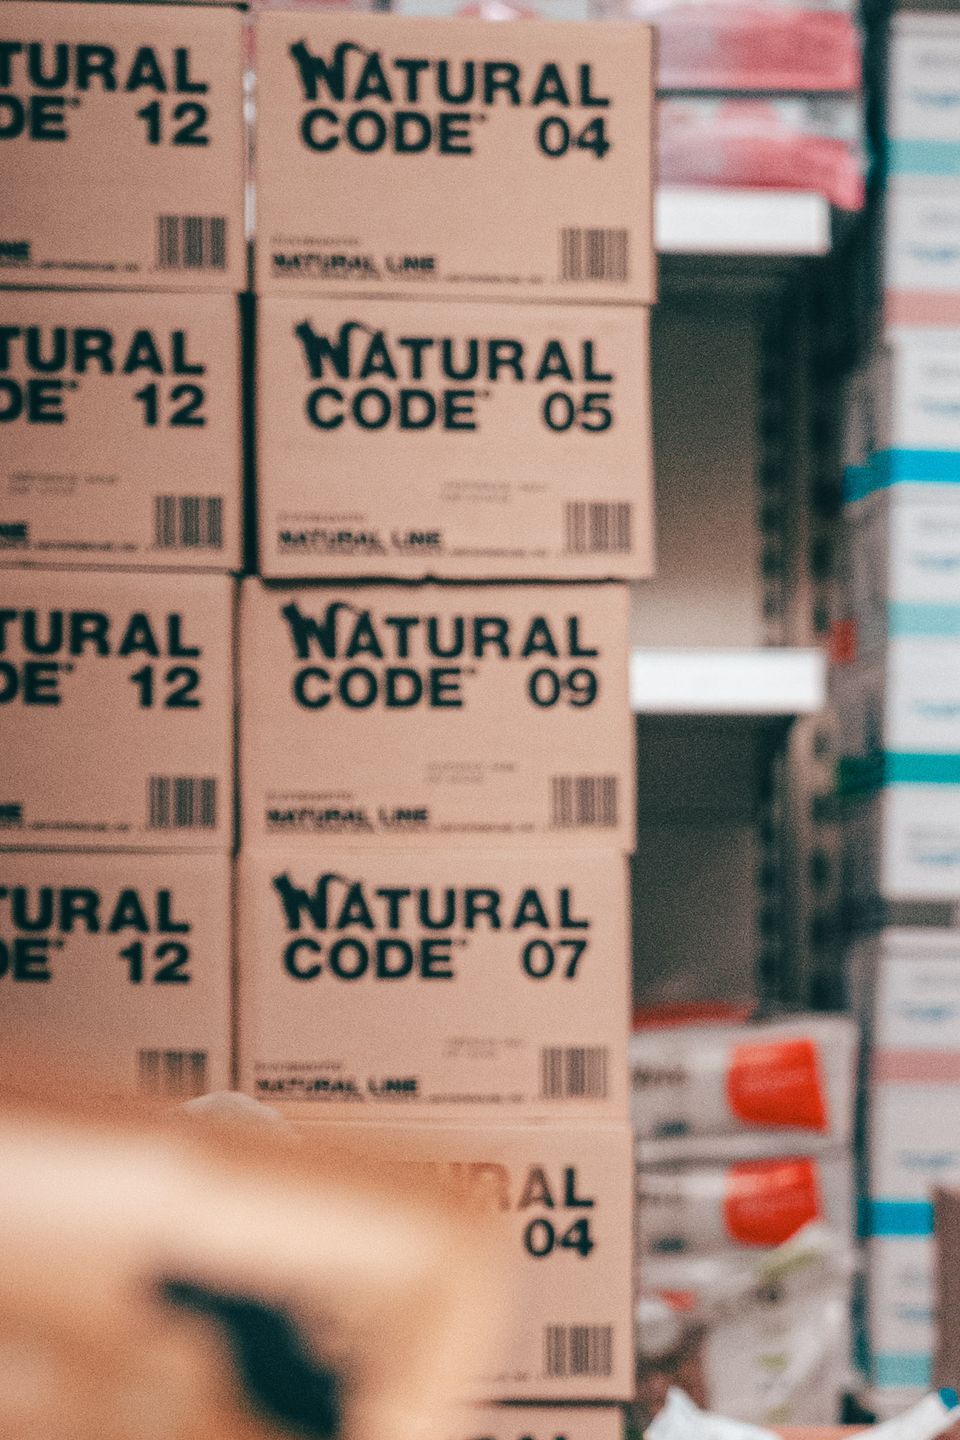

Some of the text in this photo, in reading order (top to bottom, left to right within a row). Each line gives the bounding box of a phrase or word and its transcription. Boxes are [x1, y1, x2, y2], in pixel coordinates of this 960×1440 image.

[288, 39, 610, 109] NATURAL
[137, 100, 209, 146] 12
[537, 115, 611, 159] 04
[293, 319, 613, 383] NATURAL
[134, 382, 206, 427] 12
[542, 391, 613, 433] 05
[279, 600, 599, 661] NATURAL
[129, 665, 201, 709] 12
[527, 667, 599, 709] 09
[0, 884, 191, 934] URAL
[272, 872, 590, 932] NATURAL
[119, 940, 191, 984] 12
[521, 939, 588, 980] 07
[524, 1217, 595, 1258] 04
